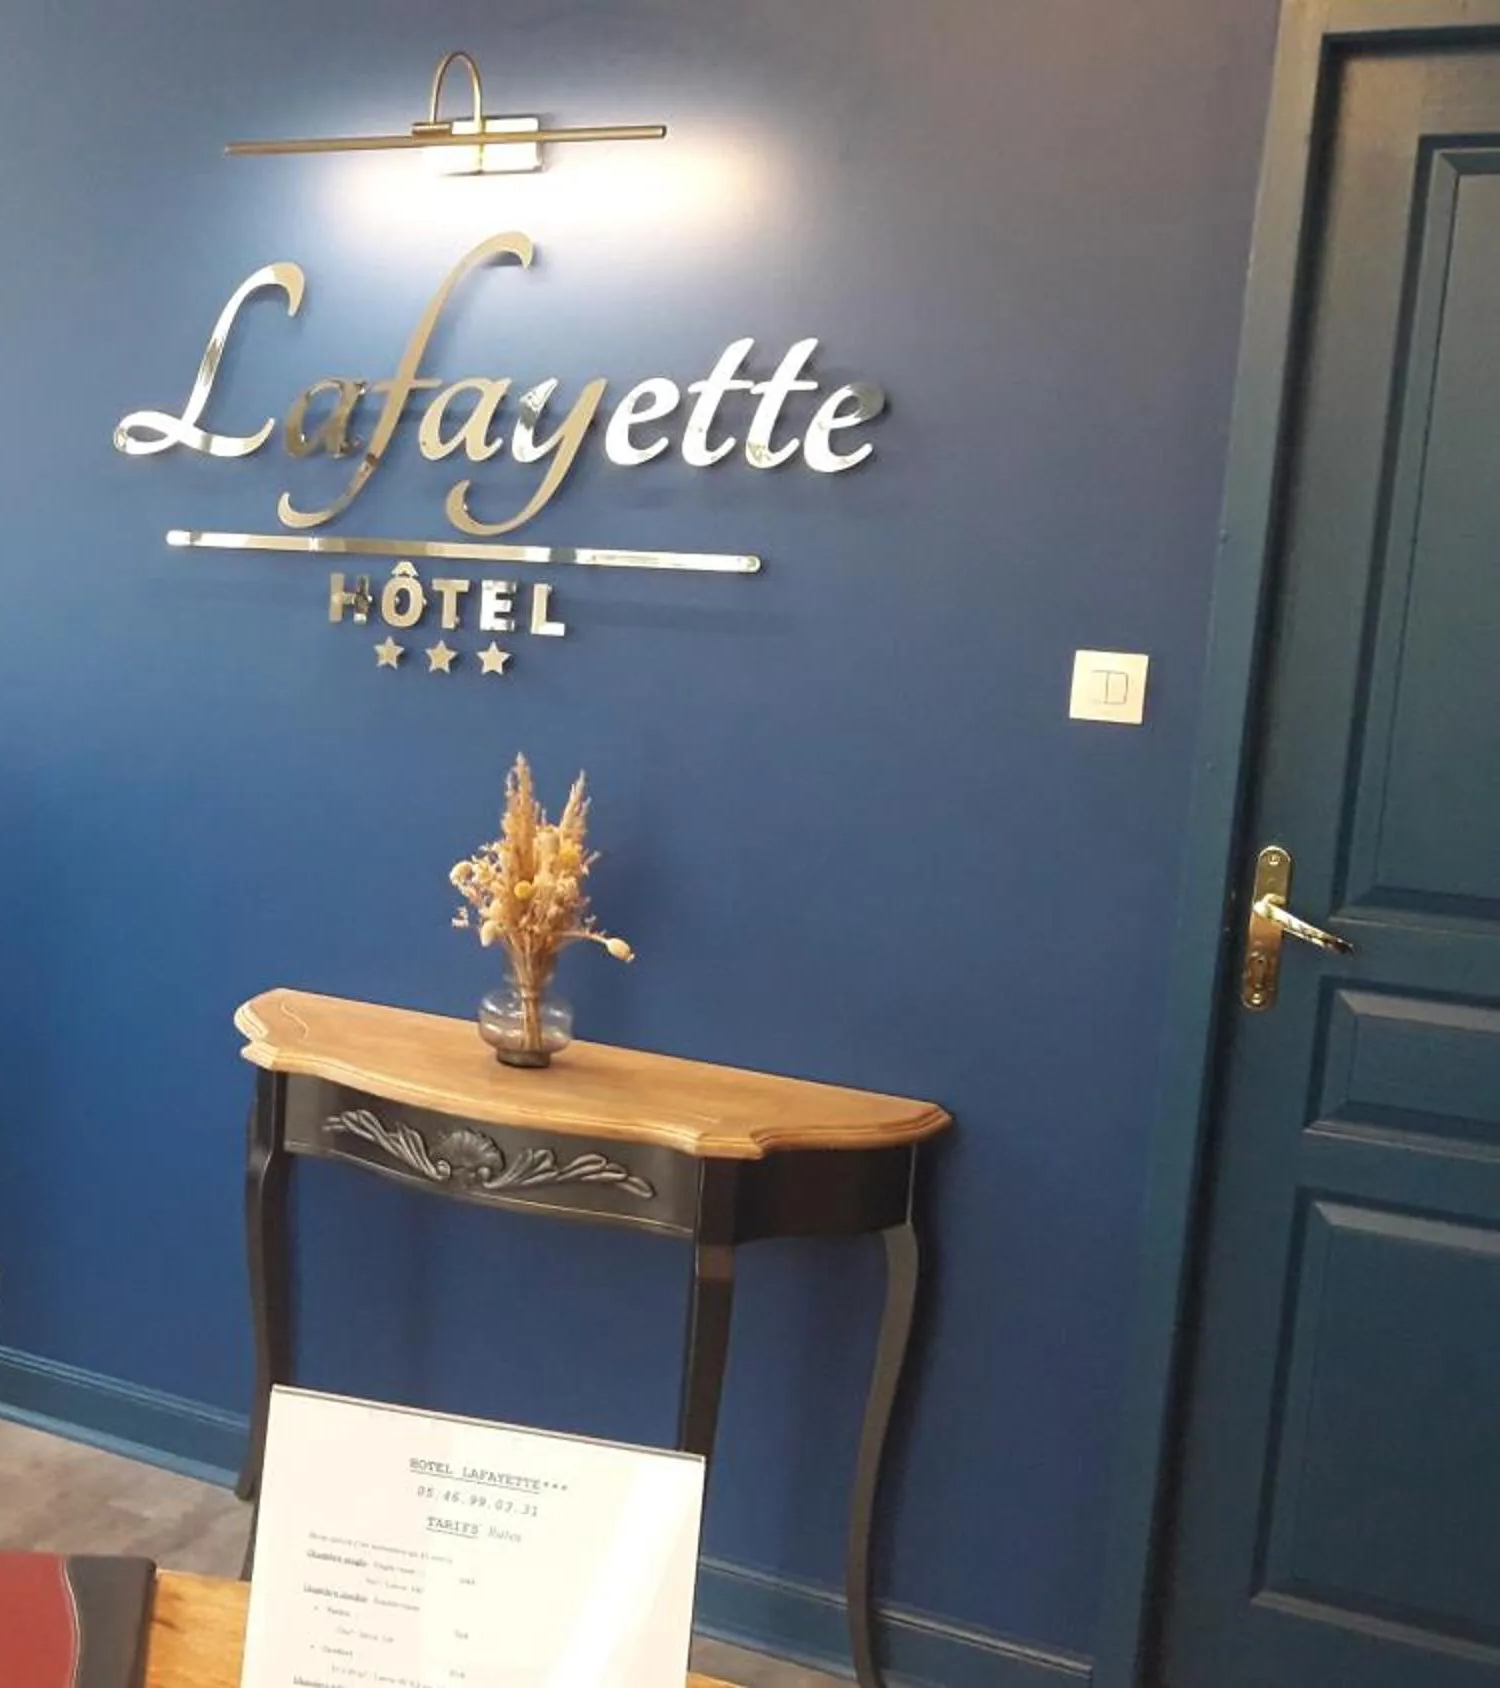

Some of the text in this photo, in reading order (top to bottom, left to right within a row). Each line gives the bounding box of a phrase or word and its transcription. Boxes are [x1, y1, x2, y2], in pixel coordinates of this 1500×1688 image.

[113, 231, 884, 535] Lafayette
[328, 562, 565, 636] HÔTEL
[409, 1457, 453, 1475] HOTEL
